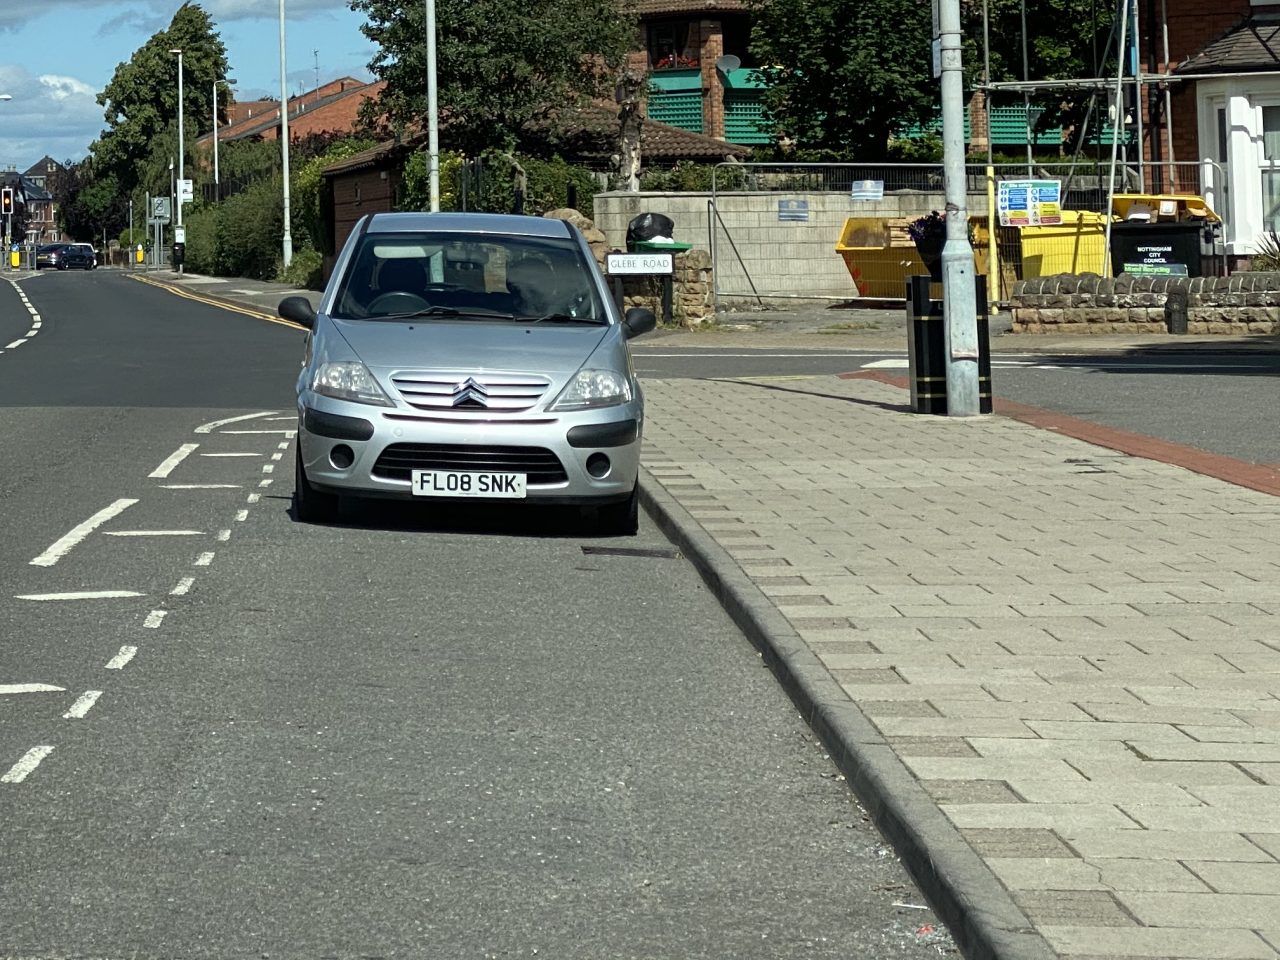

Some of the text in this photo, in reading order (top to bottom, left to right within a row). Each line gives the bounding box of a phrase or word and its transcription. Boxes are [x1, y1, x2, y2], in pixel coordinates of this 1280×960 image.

[610, 259, 670, 269] GLEBE ROAD
[420, 472, 517, 493] FL08 SNK
